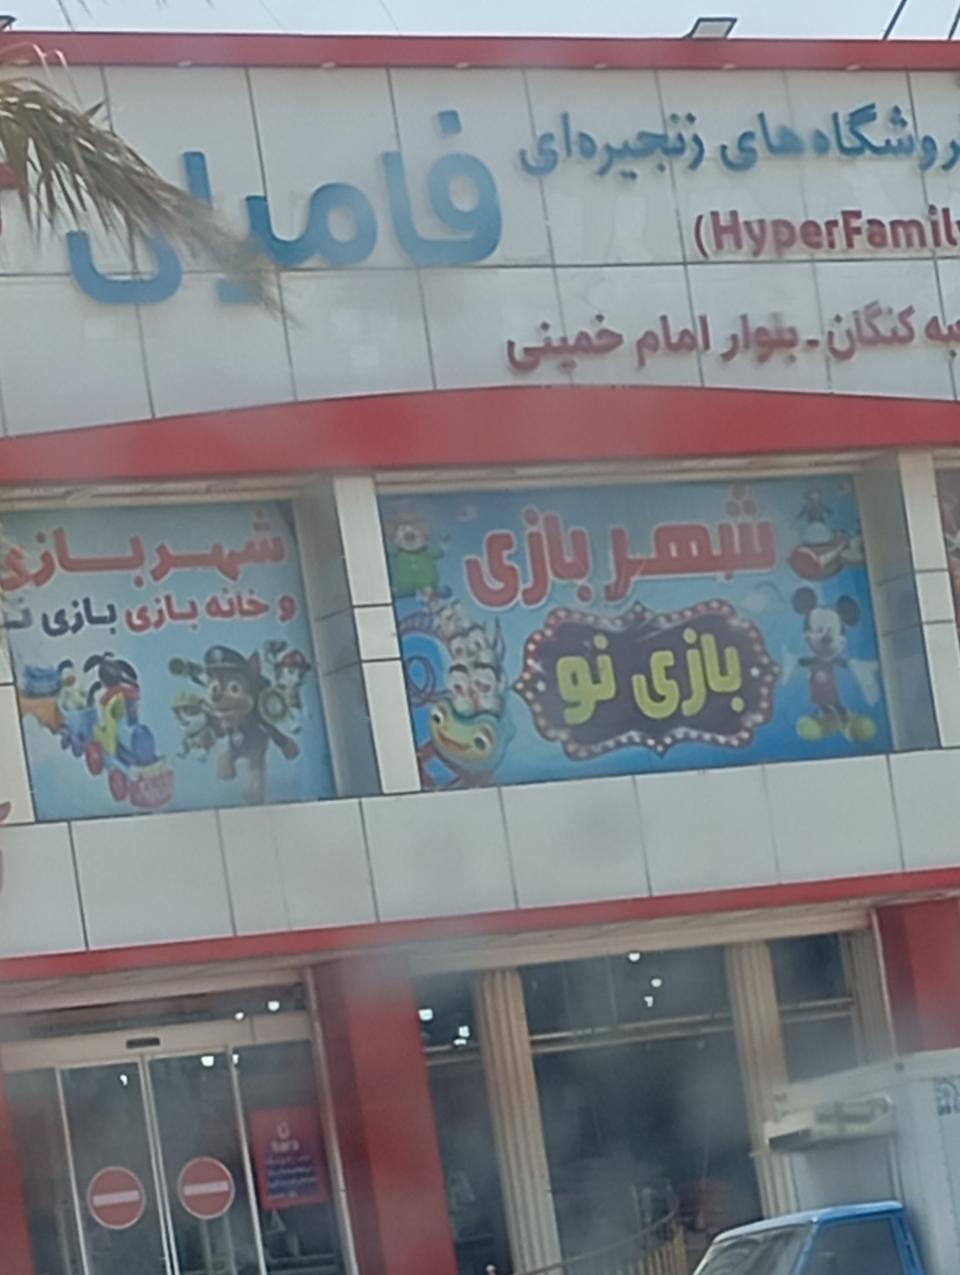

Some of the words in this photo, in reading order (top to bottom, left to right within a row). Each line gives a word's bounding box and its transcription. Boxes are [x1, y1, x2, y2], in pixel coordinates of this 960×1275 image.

[506, 314, 624, 374] خمینی
[635, 314, 710, 371] امام
[464, 506, 592, 610] بازی
[41, 596, 118, 638] بازی
[125, 594, 200, 633] بازی
[205, 586, 271, 619] خانه
[278, 594, 297, 623] و
[556, 633, 617, 726] نو
[631, 626, 744, 721] بازی
